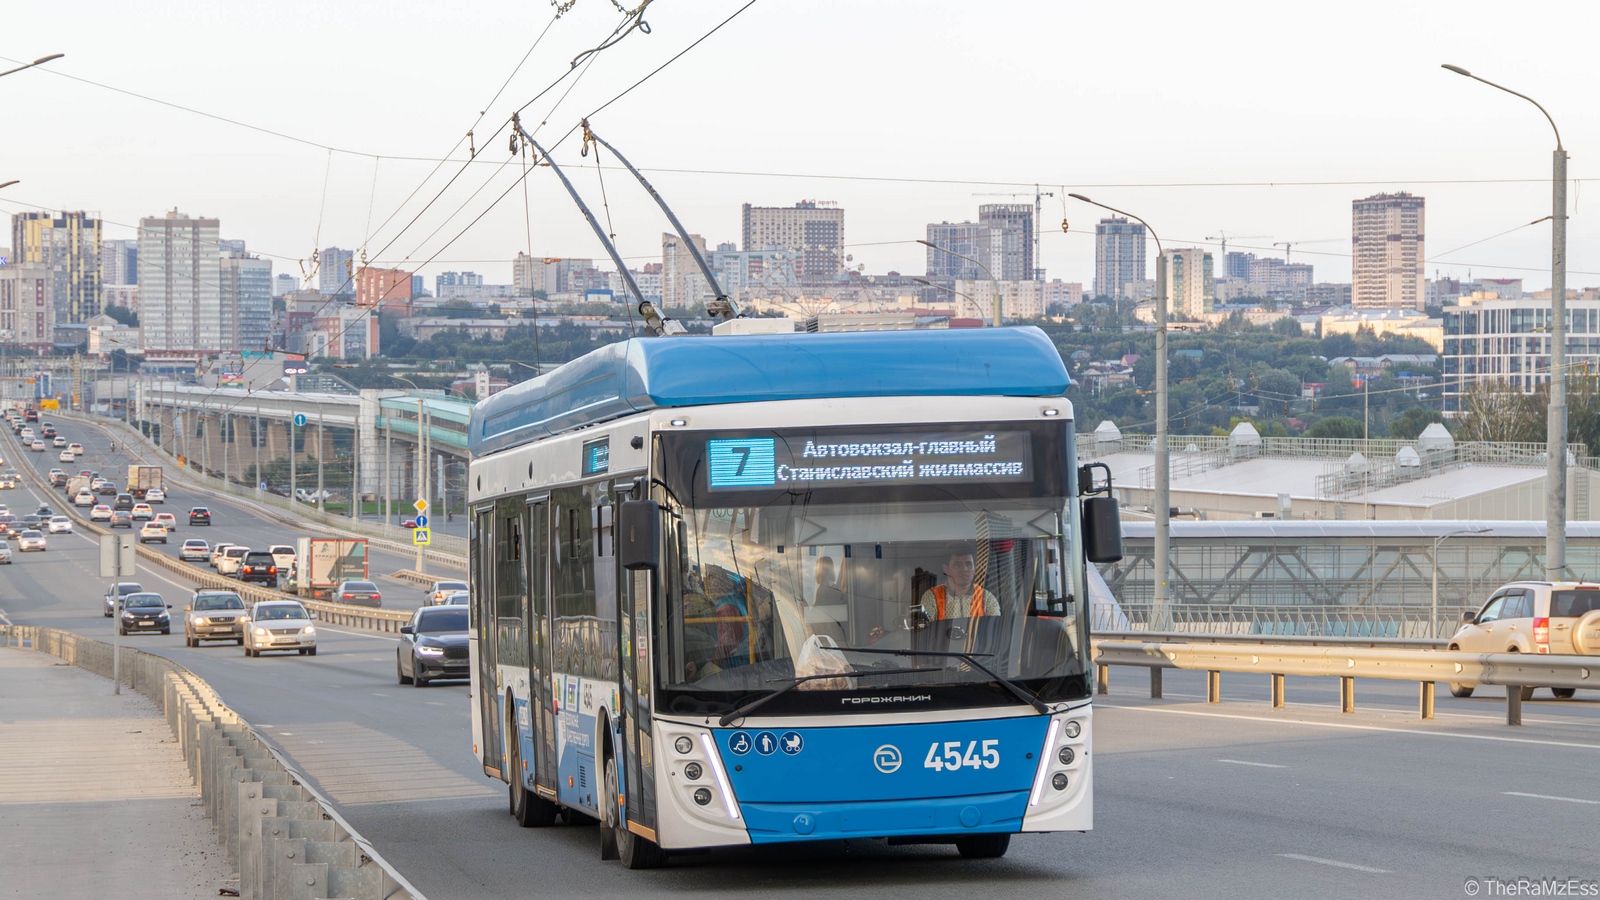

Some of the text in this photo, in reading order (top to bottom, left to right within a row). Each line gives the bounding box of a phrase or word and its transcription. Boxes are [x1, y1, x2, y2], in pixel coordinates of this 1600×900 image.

[803, 434, 996, 458] Автовокзал-главный
[732, 446, 751, 477] 7
[777, 459, 1024, 481] Станиславский жилмассив
[841, 694, 932, 704] ГОРОЖАНИН
[923, 739, 1000, 772] 4545
